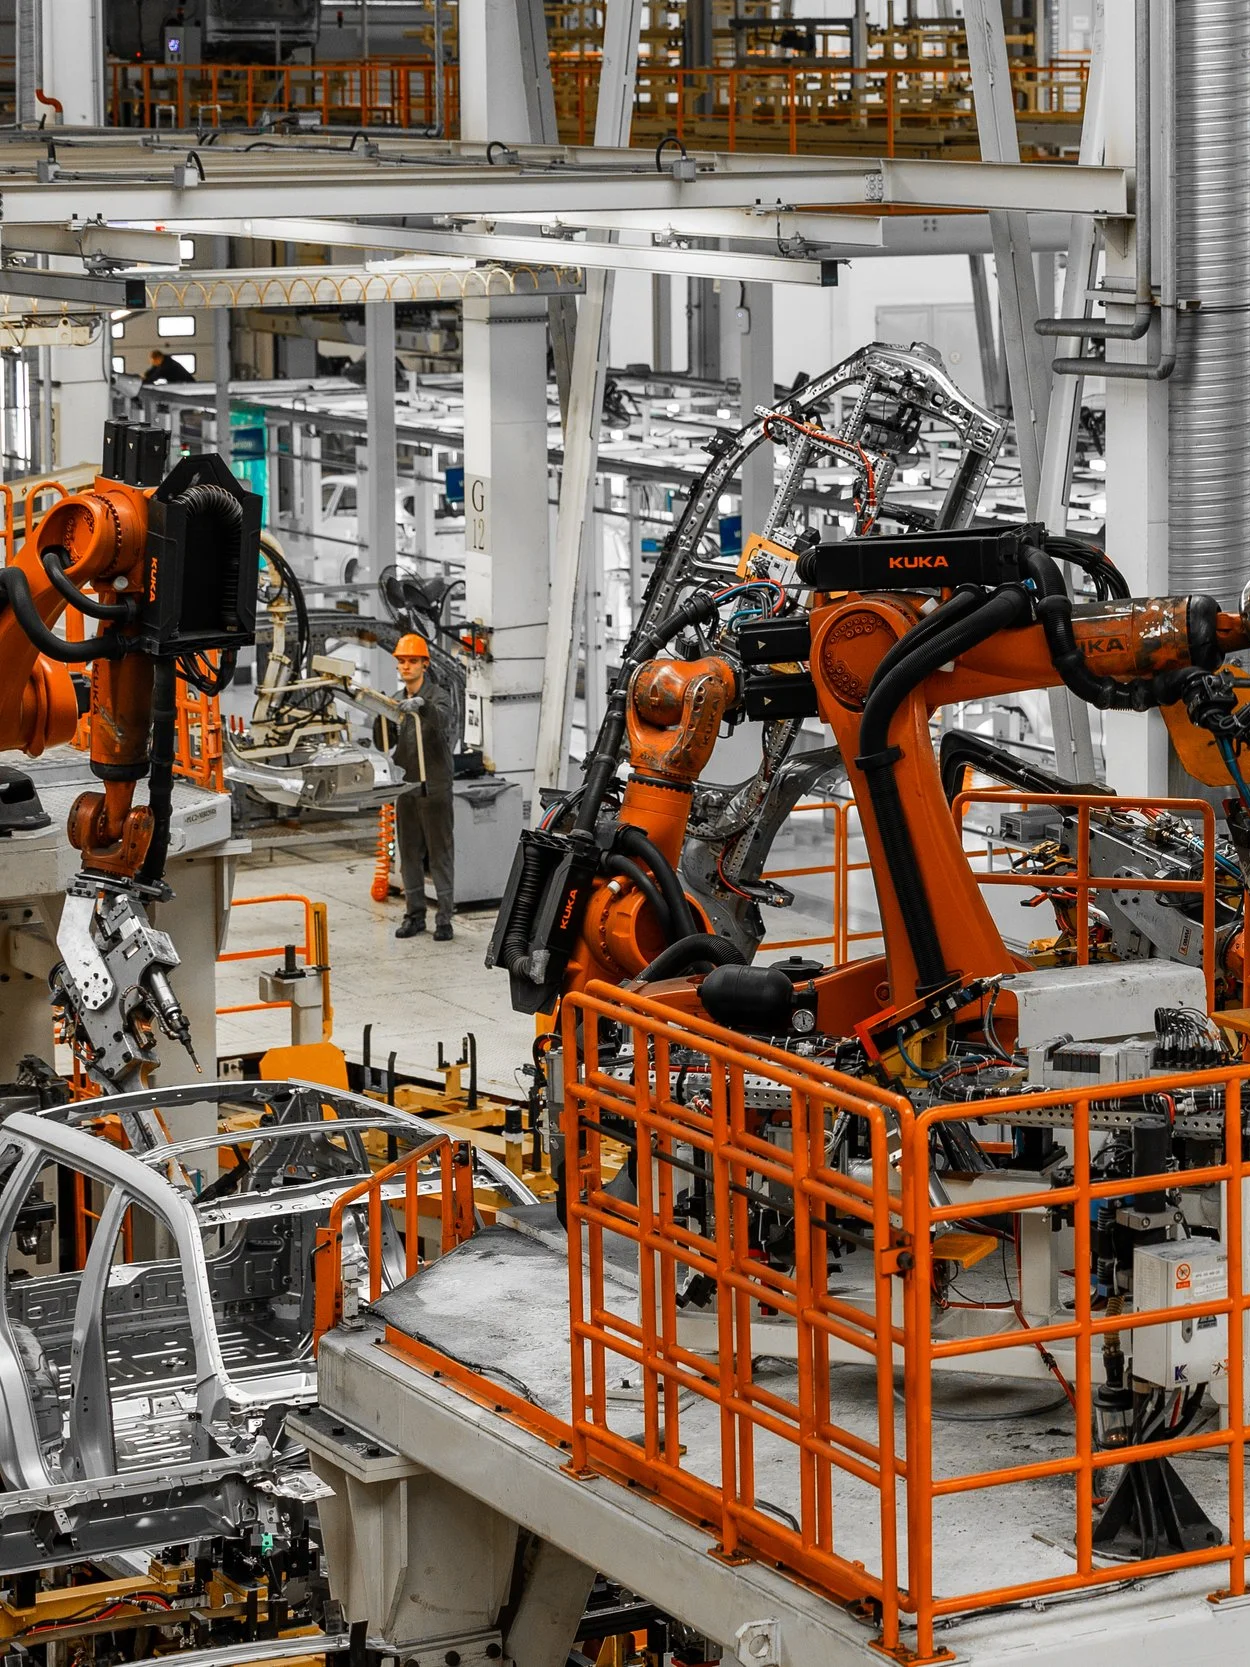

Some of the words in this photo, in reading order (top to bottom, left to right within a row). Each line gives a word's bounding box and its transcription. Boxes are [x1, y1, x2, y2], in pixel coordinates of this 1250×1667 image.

[472, 480, 484, 512] G
[473, 518, 484, 550] 12
[149, 557, 158, 602] KUKA
[889, 556, 949, 568] KUKA
[92, 663, 100, 715] KUKA
[560, 889, 578, 929] KUKA
